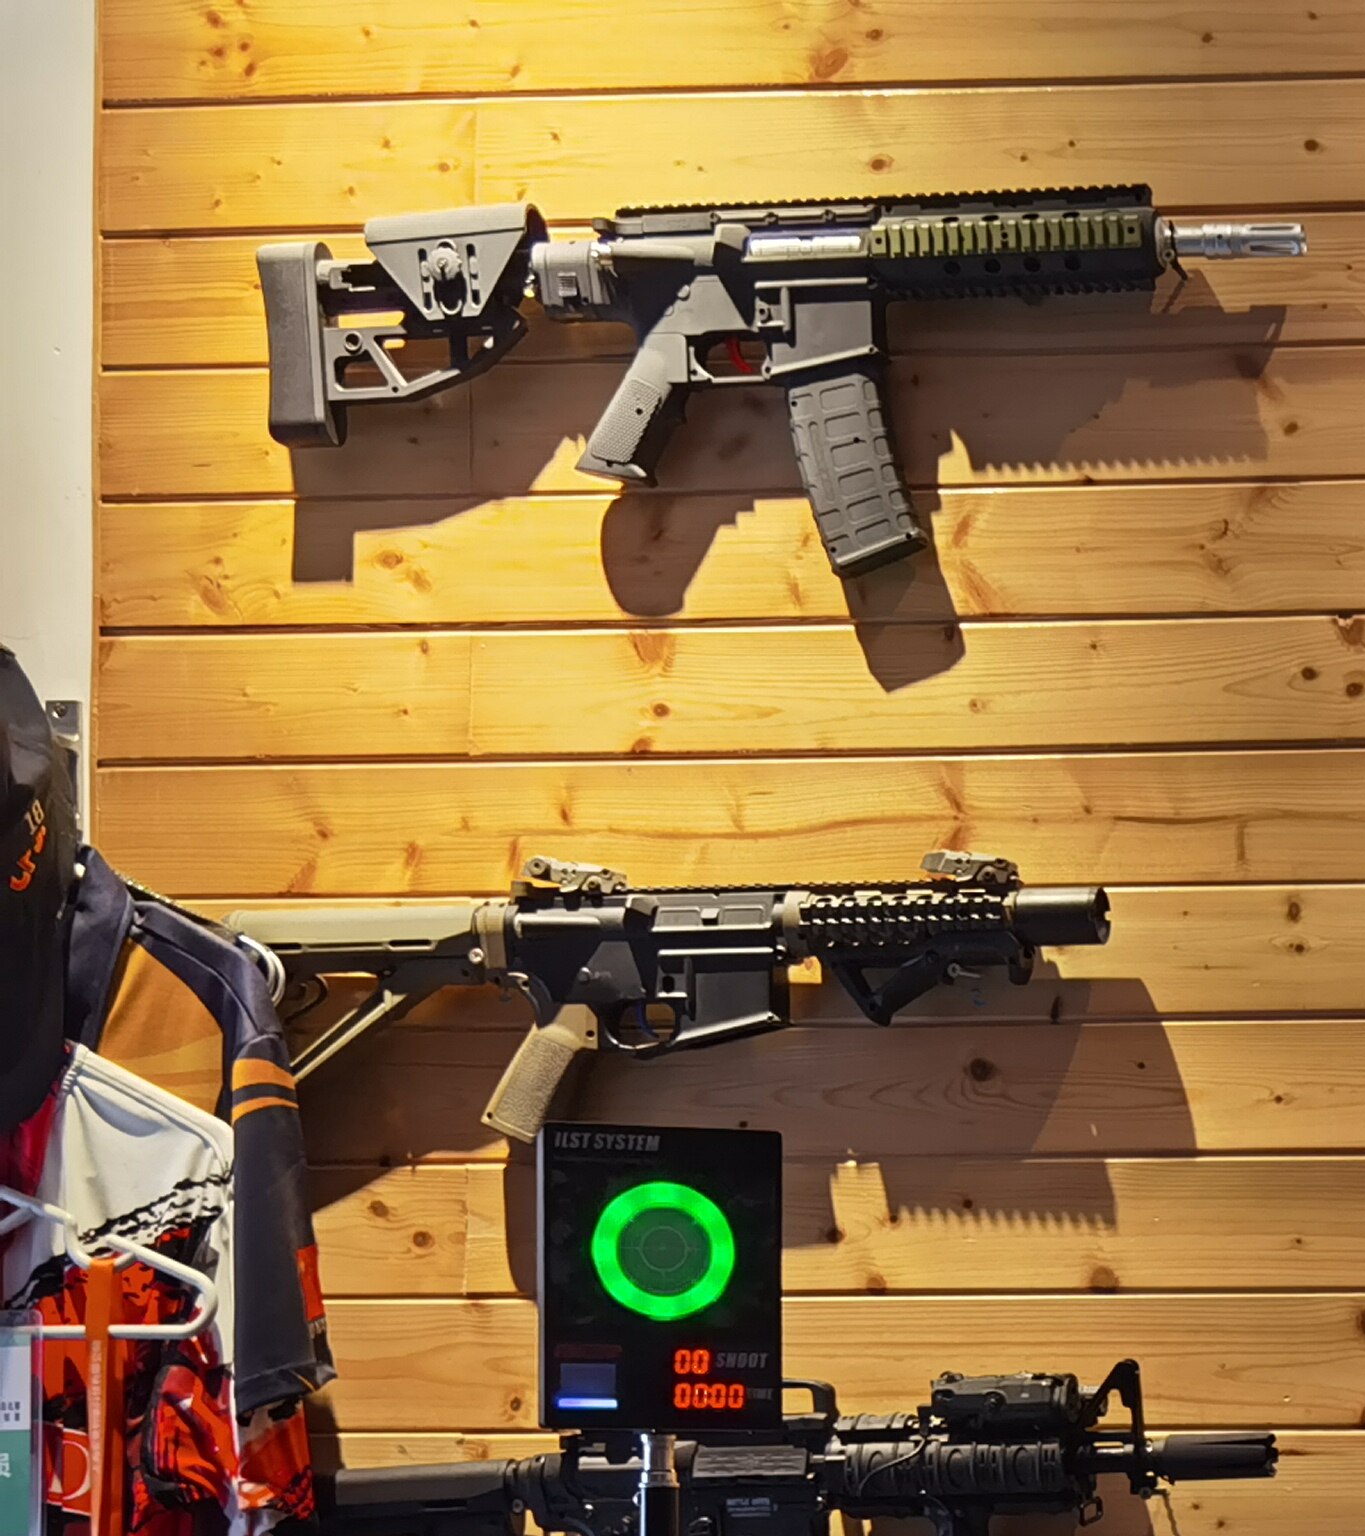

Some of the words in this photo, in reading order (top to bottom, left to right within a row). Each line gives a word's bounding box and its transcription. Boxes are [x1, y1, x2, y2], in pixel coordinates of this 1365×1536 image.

[593, 1132, 661, 1152] SYSTEM
[673, 1348, 710, 1375] 00
[715, 1351, 769, 1369] SHOOT
